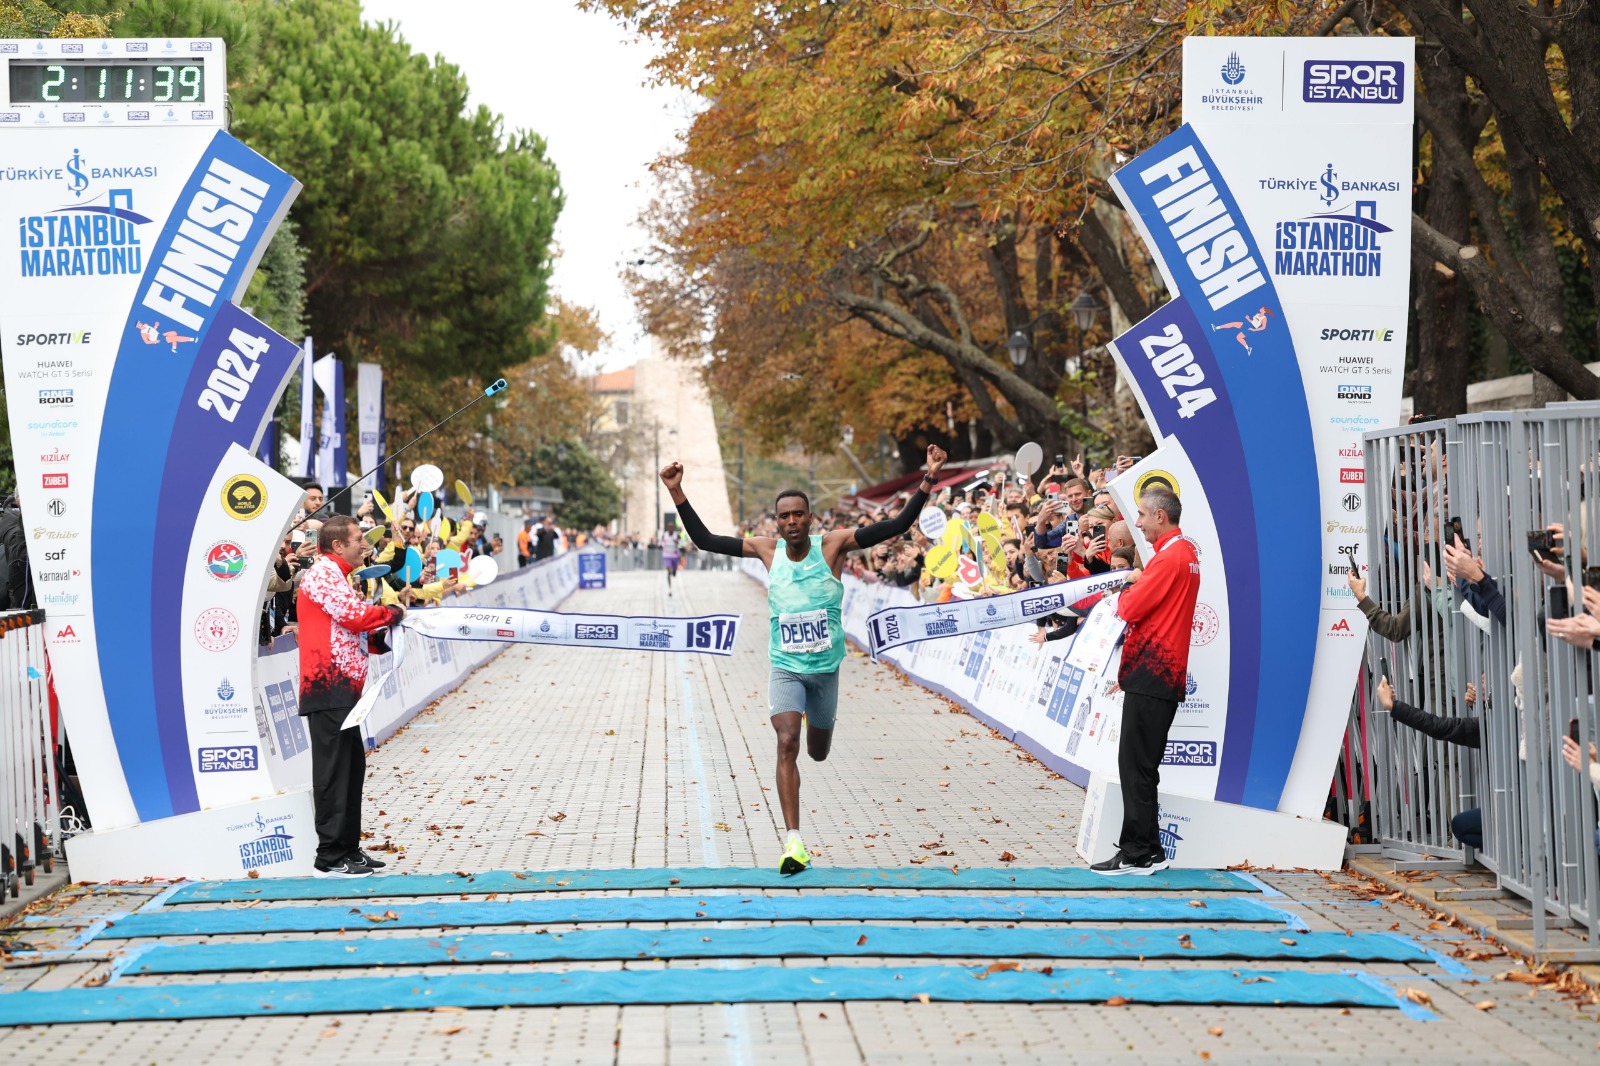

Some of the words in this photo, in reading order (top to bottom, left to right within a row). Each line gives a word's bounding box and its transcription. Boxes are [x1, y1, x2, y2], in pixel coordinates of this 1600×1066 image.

[1309, 64, 1398, 85] SPOR
[42, 66, 201, 101] 2:11:39
[1202, 94, 1263, 105] BÜYÜKŞEHİR
[0, 167, 63, 181] TÜRKİYE
[91, 167, 158, 179] BANKASI
[1259, 178, 1317, 191] TÜRKİYE
[1341, 181, 1400, 192] BANKASI
[1140, 145, 1267, 312] FINISH
[142, 157, 271, 333] FINISH
[21, 247, 141, 277] MARATONU
[1275, 251, 1382, 277] MARATHON
[16, 330, 91, 346] SPORTIVE
[1320, 328, 1394, 342] SPORTIVE
[37, 360, 73, 368] HUAWEI
[1339, 356, 1374, 364] HUAWEI
[18, 371, 49, 379] WATCH
[65, 370, 70, 378] 5
[72, 369, 93, 377] Serisi
[197, 327, 271, 423] 2024
[1139, 323, 1218, 419] 2024
[1320, 366, 1349, 374] WATCH
[1351, 366, 1363, 374] GT
[1365, 366, 1370, 375] 5
[1372, 366, 1392, 375] Serisi
[27, 421, 79, 429] soundcore
[1330, 416, 1380, 424] soundcore
[41, 454, 70, 462] KIZILAY
[48, 500, 65, 516] MG
[1343, 494, 1360, 511] MG
[47, 531, 79, 539] Tchibo
[45, 549, 66, 561] saf
[39, 570, 70, 581] karnaval
[44, 592, 79, 604] Hamidiye
[1024, 596, 1062, 610] SPOR
[577, 625, 615, 634] SPOR
[780, 619, 829, 645] DEJENE
[885, 614, 901, 642] 2024
[201, 748, 255, 762] SPOR
[1163, 812, 1191, 823] BANKASI
[241, 848, 294, 870] MARATONU
